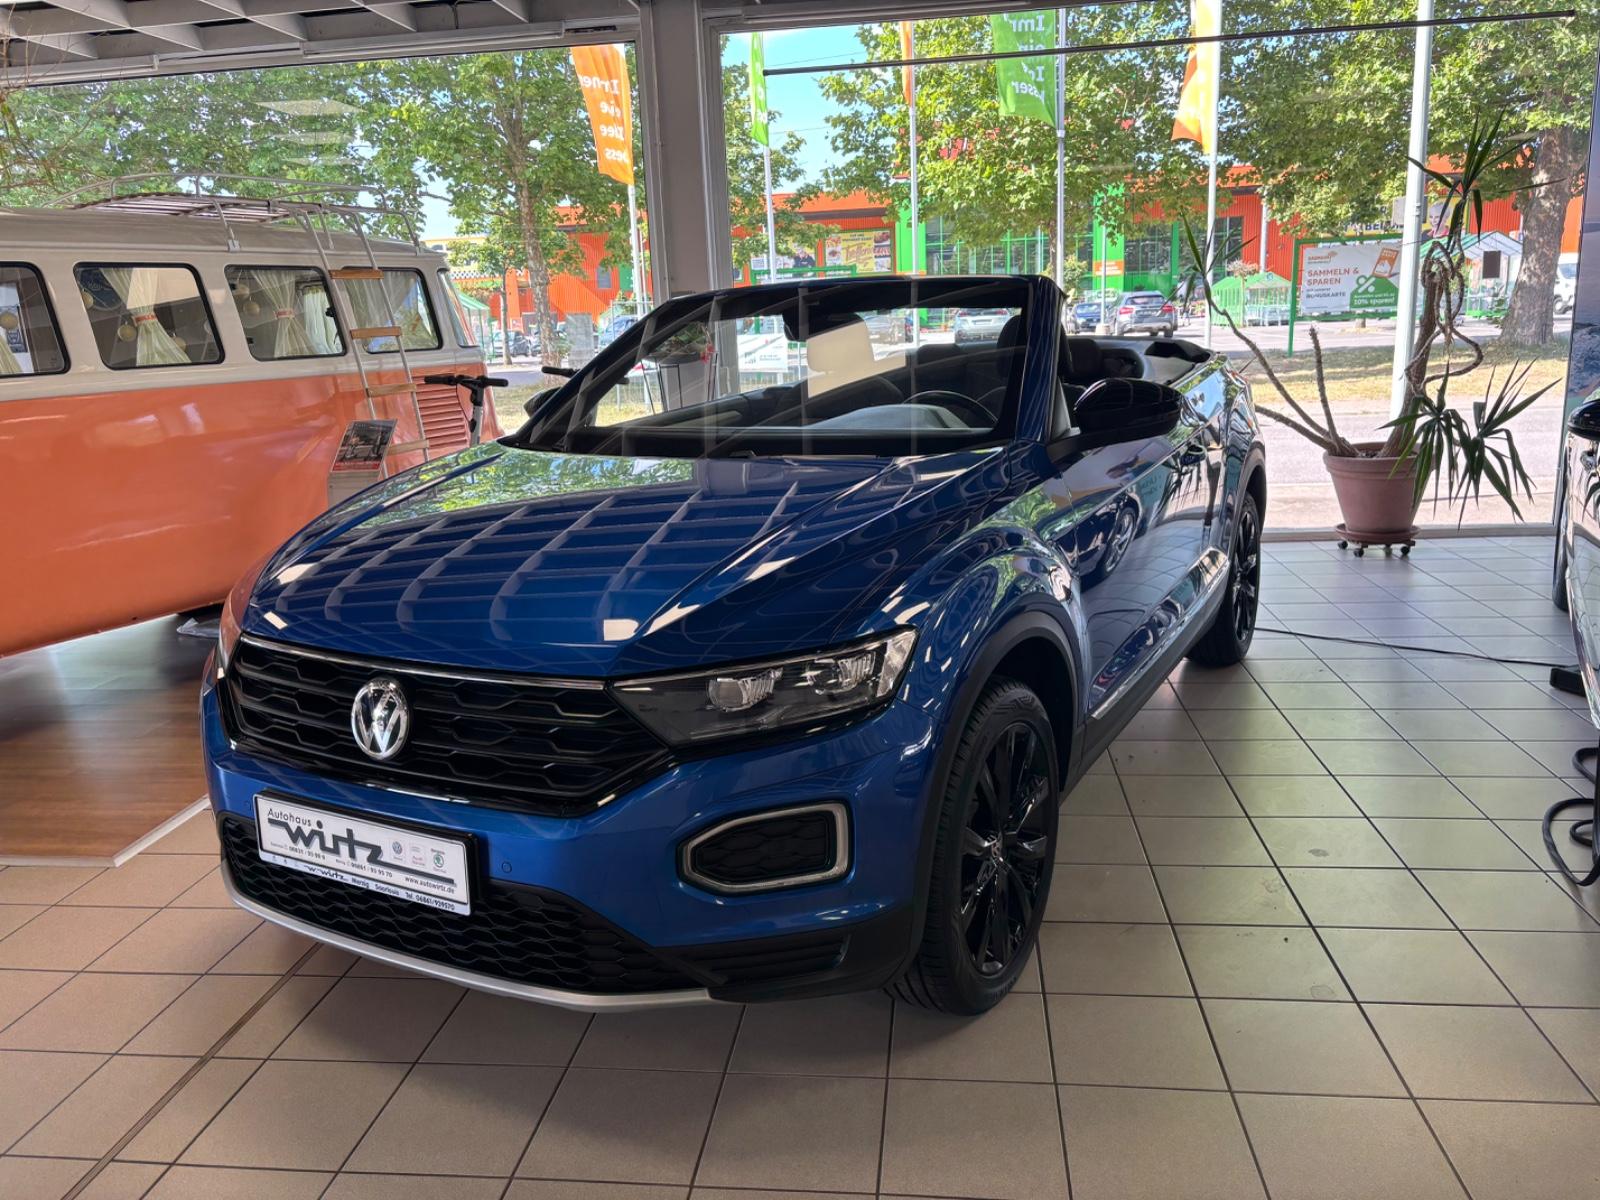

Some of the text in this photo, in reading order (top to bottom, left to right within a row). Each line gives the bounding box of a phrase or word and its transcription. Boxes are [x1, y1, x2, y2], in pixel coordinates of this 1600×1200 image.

[1308, 268, 1350, 278] SAMMELN
[1307, 278, 1341, 287] SPAREN
[267, 807, 312, 828] Autohaus
[405, 876, 455, 894] www.autowirtz.de
